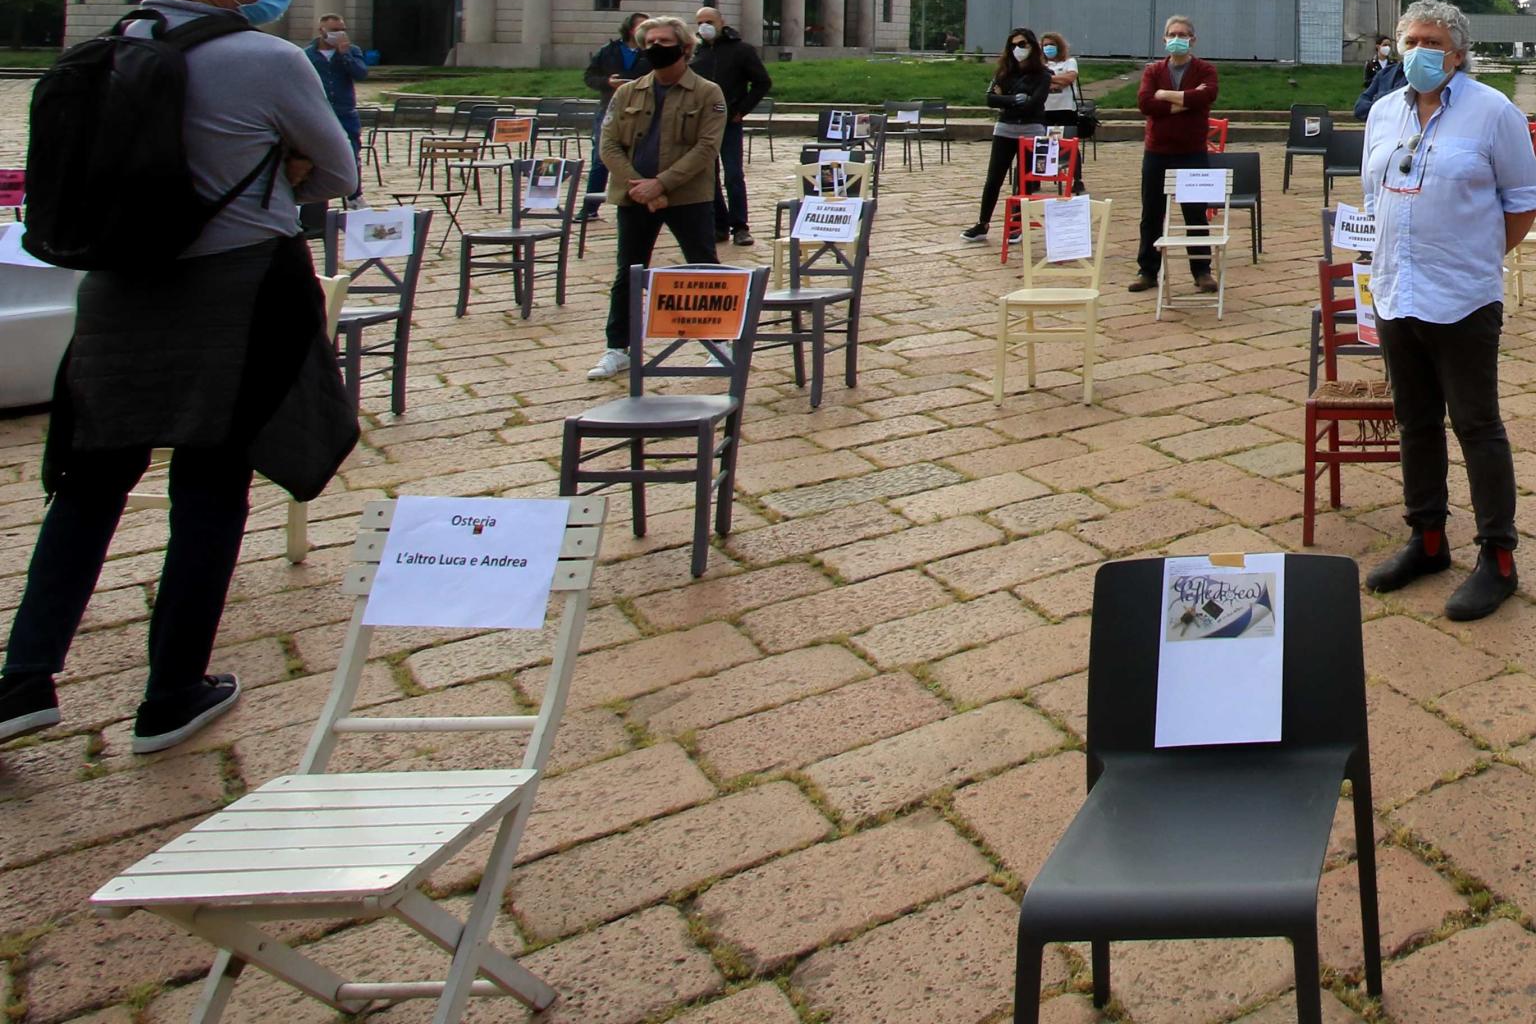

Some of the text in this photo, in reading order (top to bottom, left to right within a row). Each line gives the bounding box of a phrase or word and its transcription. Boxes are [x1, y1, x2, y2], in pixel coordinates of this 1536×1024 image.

[804, 212, 852, 225] FALLIAMO!
[673, 280, 684, 289] SE
[657, 293, 740, 312] FALLIAMO!
[451, 514, 496, 528] Osteria
[396, 552, 528, 568] L'altro Luca e Andrea
